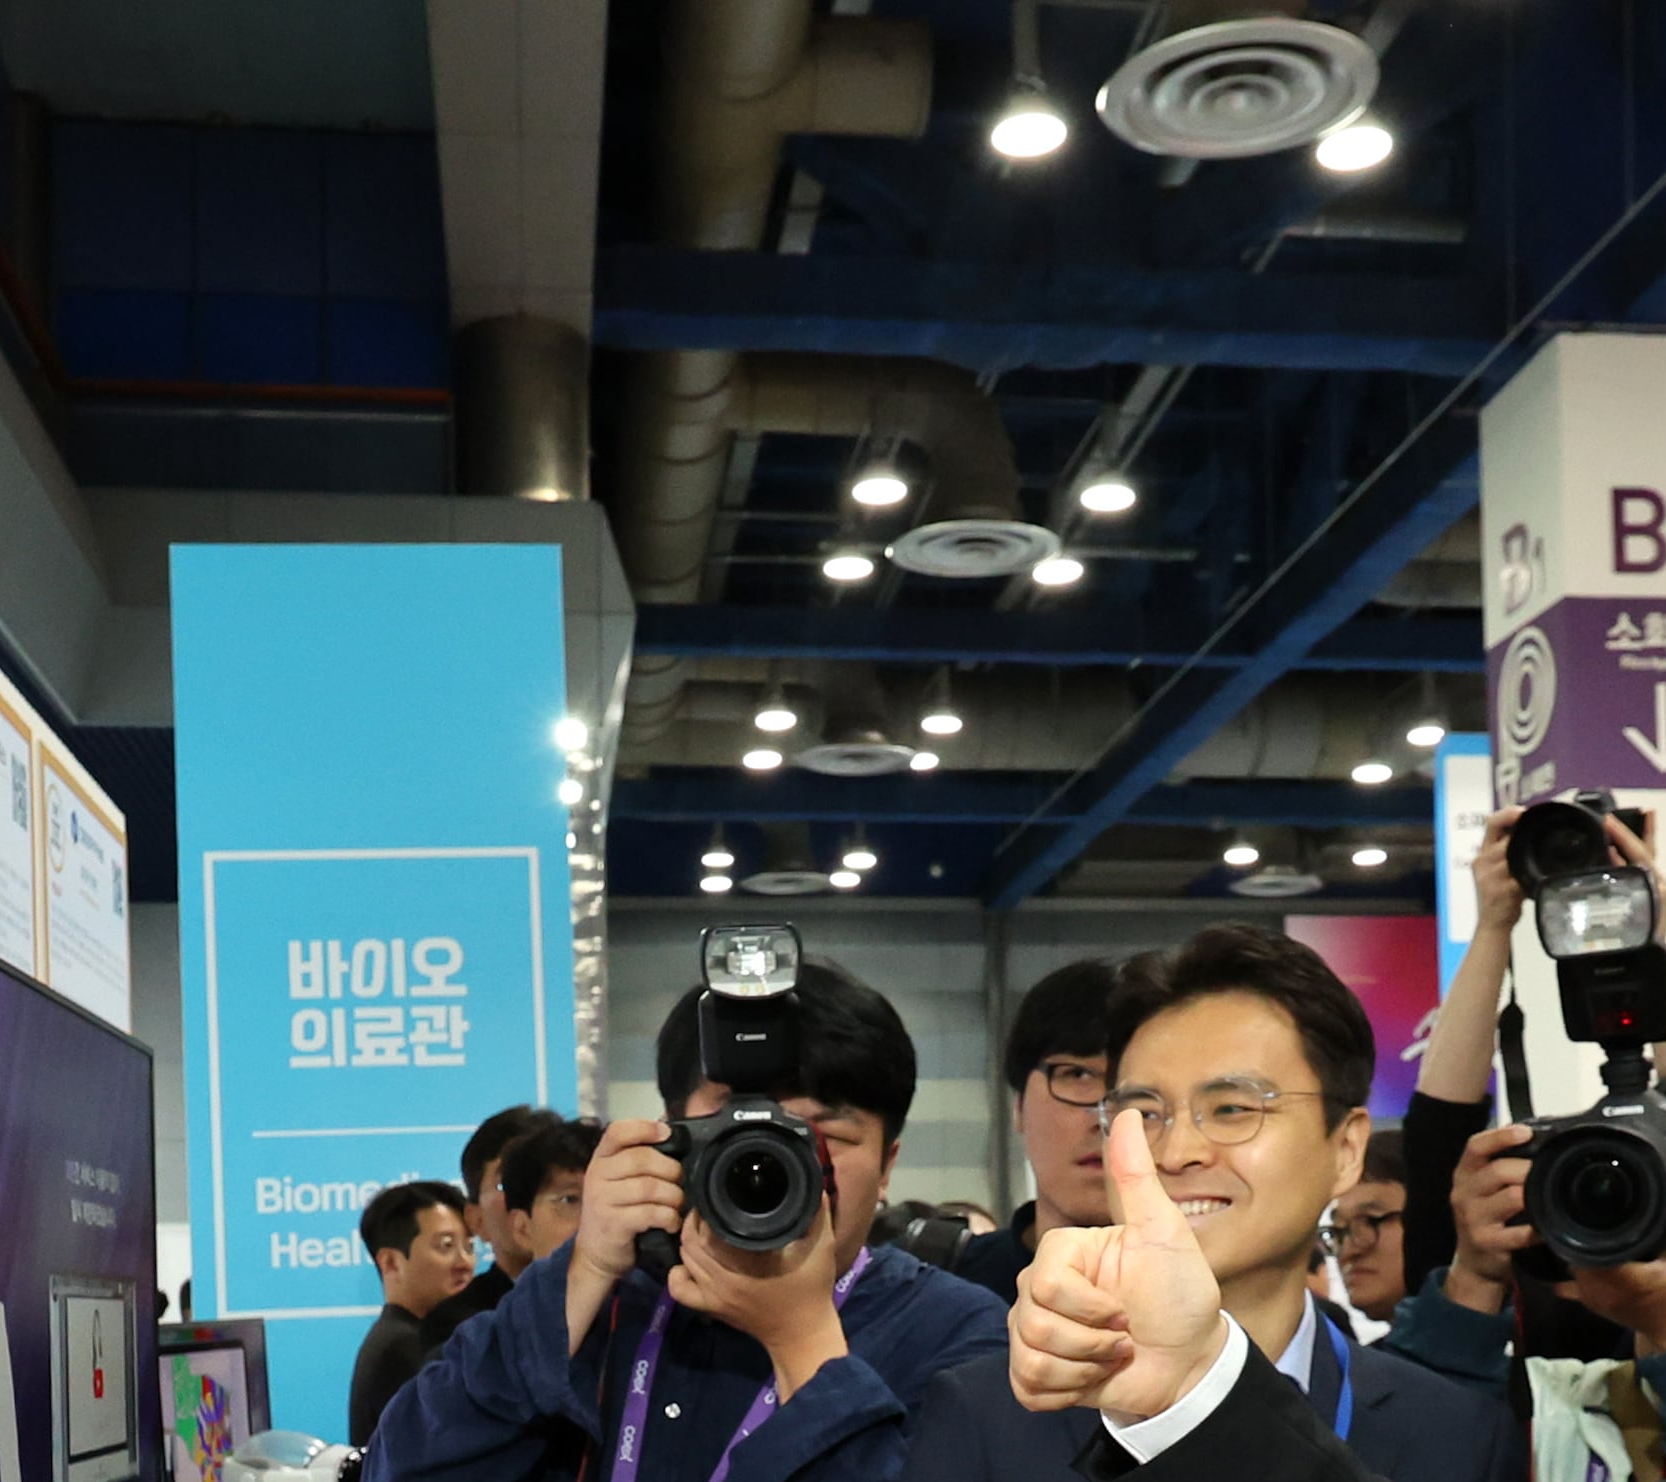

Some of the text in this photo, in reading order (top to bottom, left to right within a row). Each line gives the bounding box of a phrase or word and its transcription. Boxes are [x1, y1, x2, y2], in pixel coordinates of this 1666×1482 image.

[287, 936, 469, 1000] 바이오
[289, 1005, 471, 1069] 의료관
[733, 1109, 772, 1121] Canon
[632, 1359, 650, 1395] coex
[619, 1425, 636, 1463] coex
